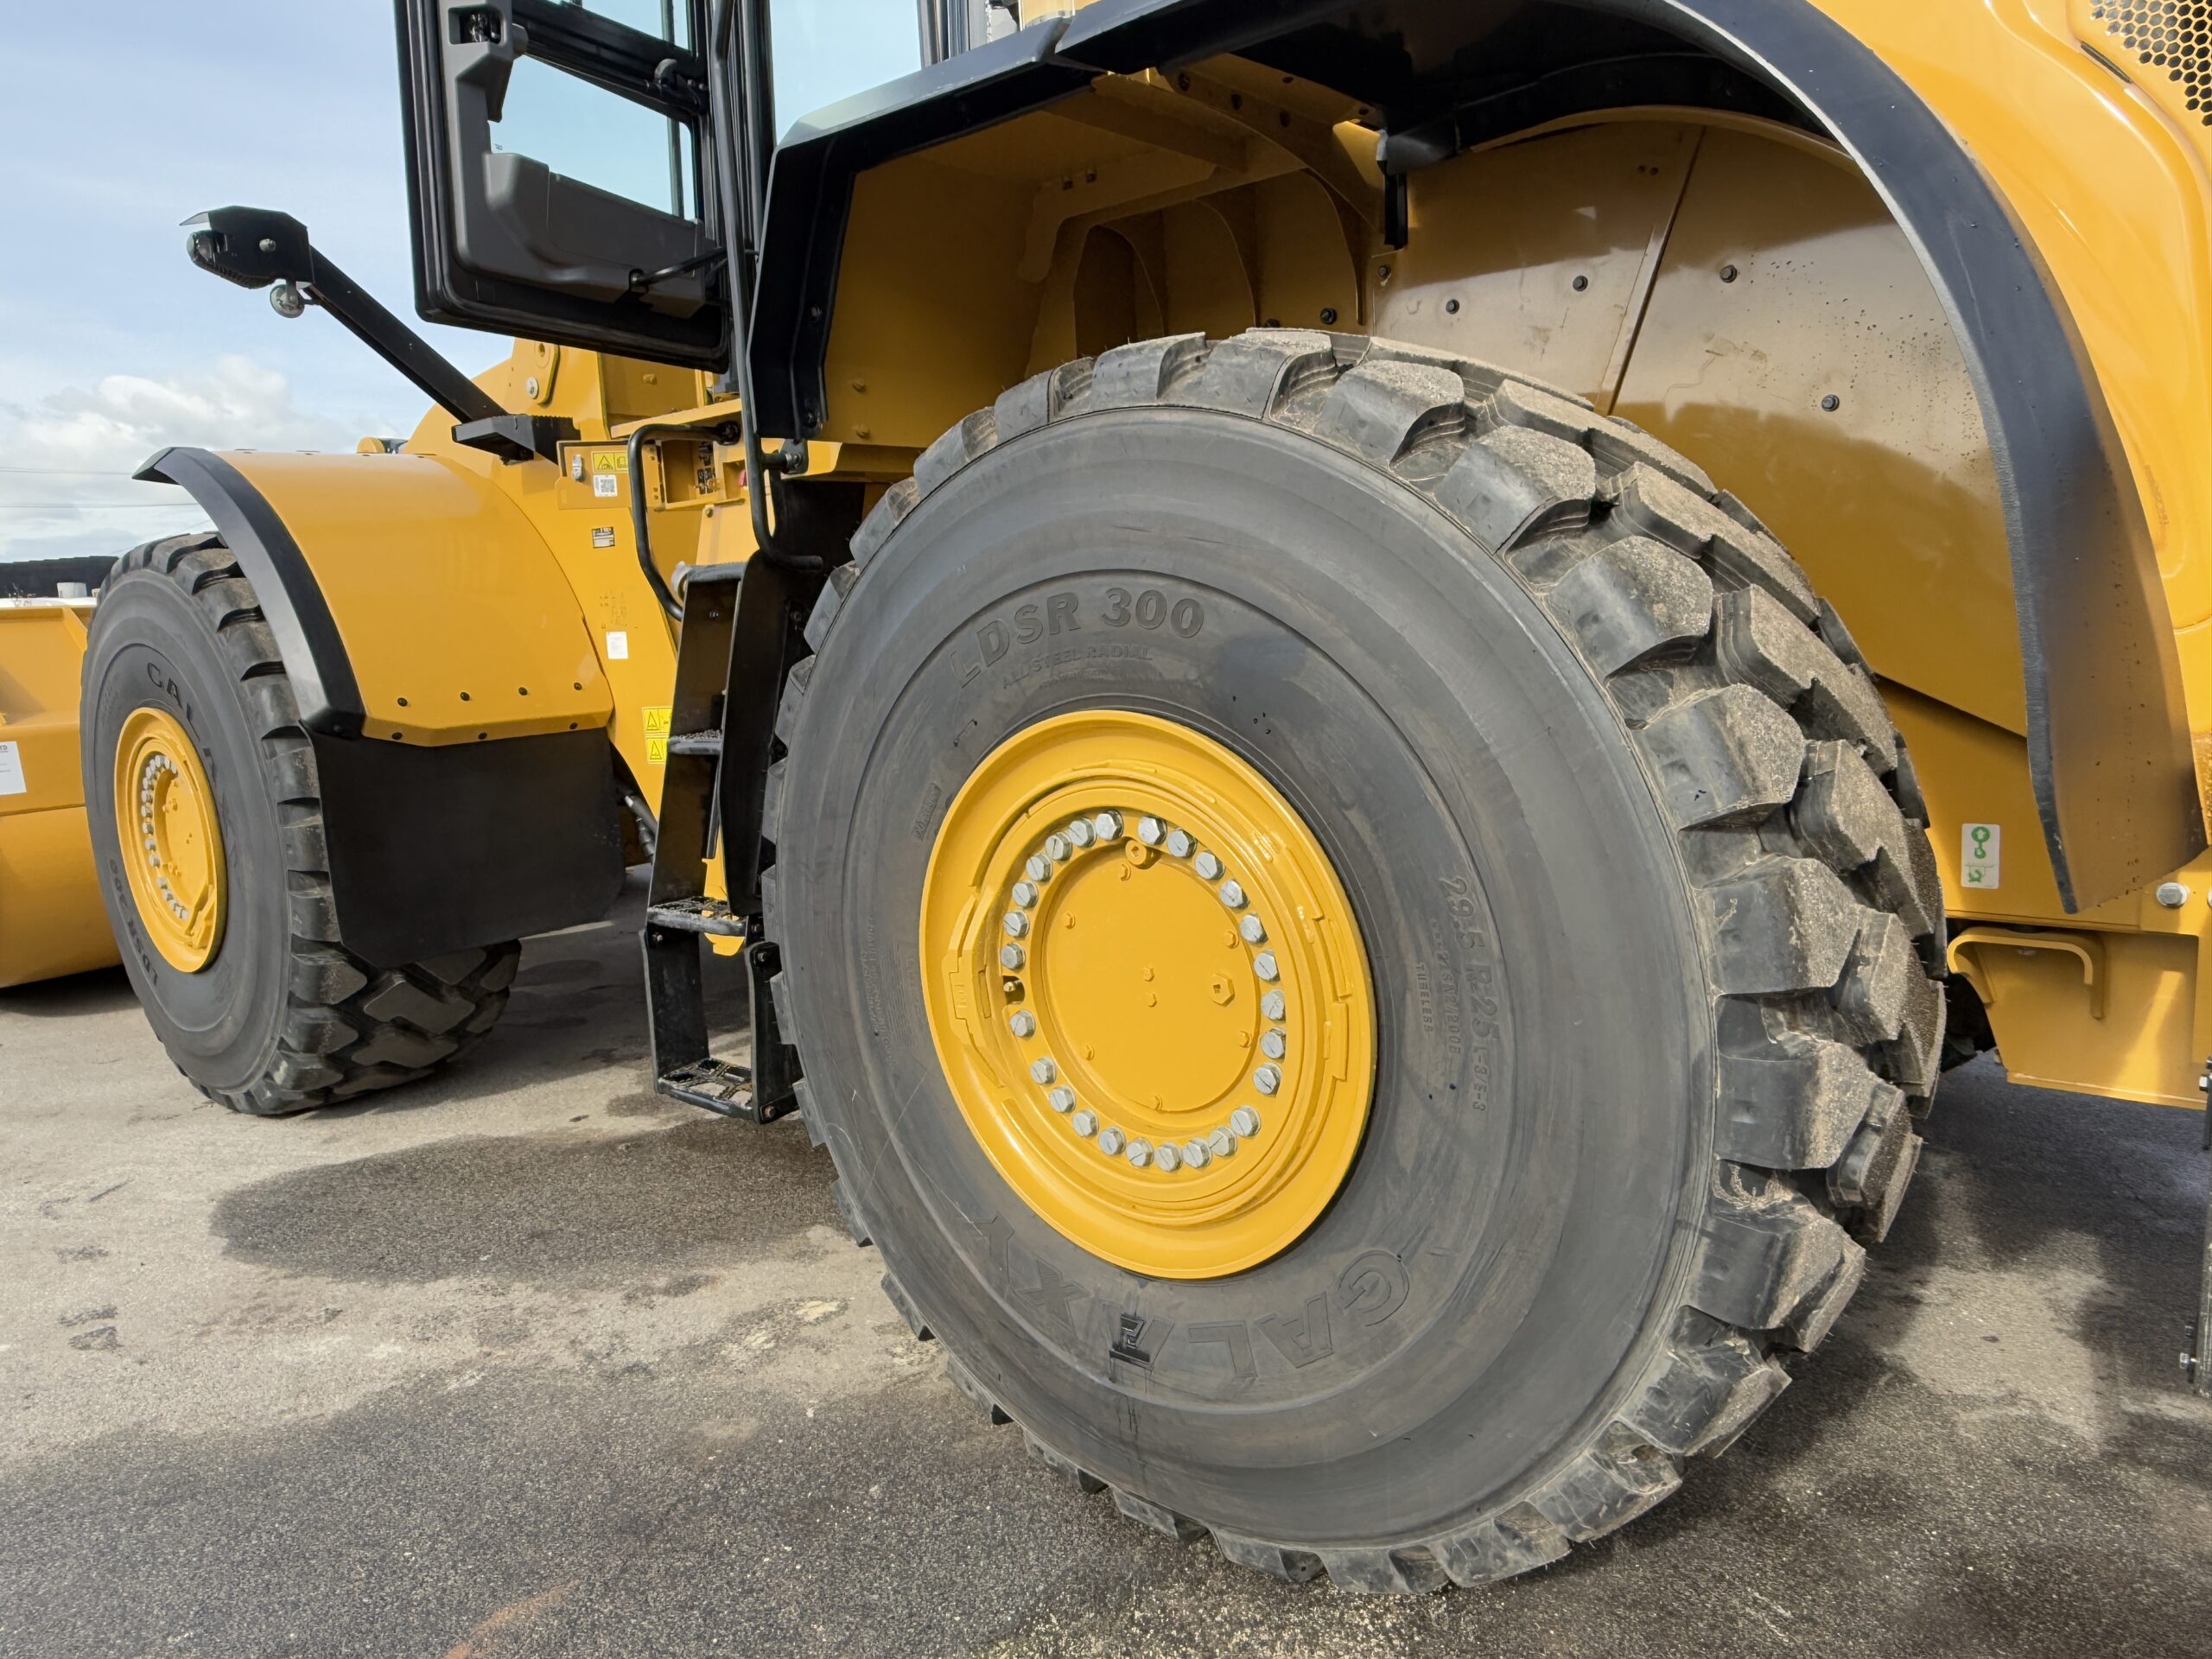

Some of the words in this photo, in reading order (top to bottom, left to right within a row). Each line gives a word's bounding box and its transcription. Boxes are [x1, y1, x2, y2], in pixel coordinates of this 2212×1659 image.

[948, 591, 1081, 689] LDSR
[1101, 587, 1205, 639] 300
[1032, 647, 1081, 672] STEEL
